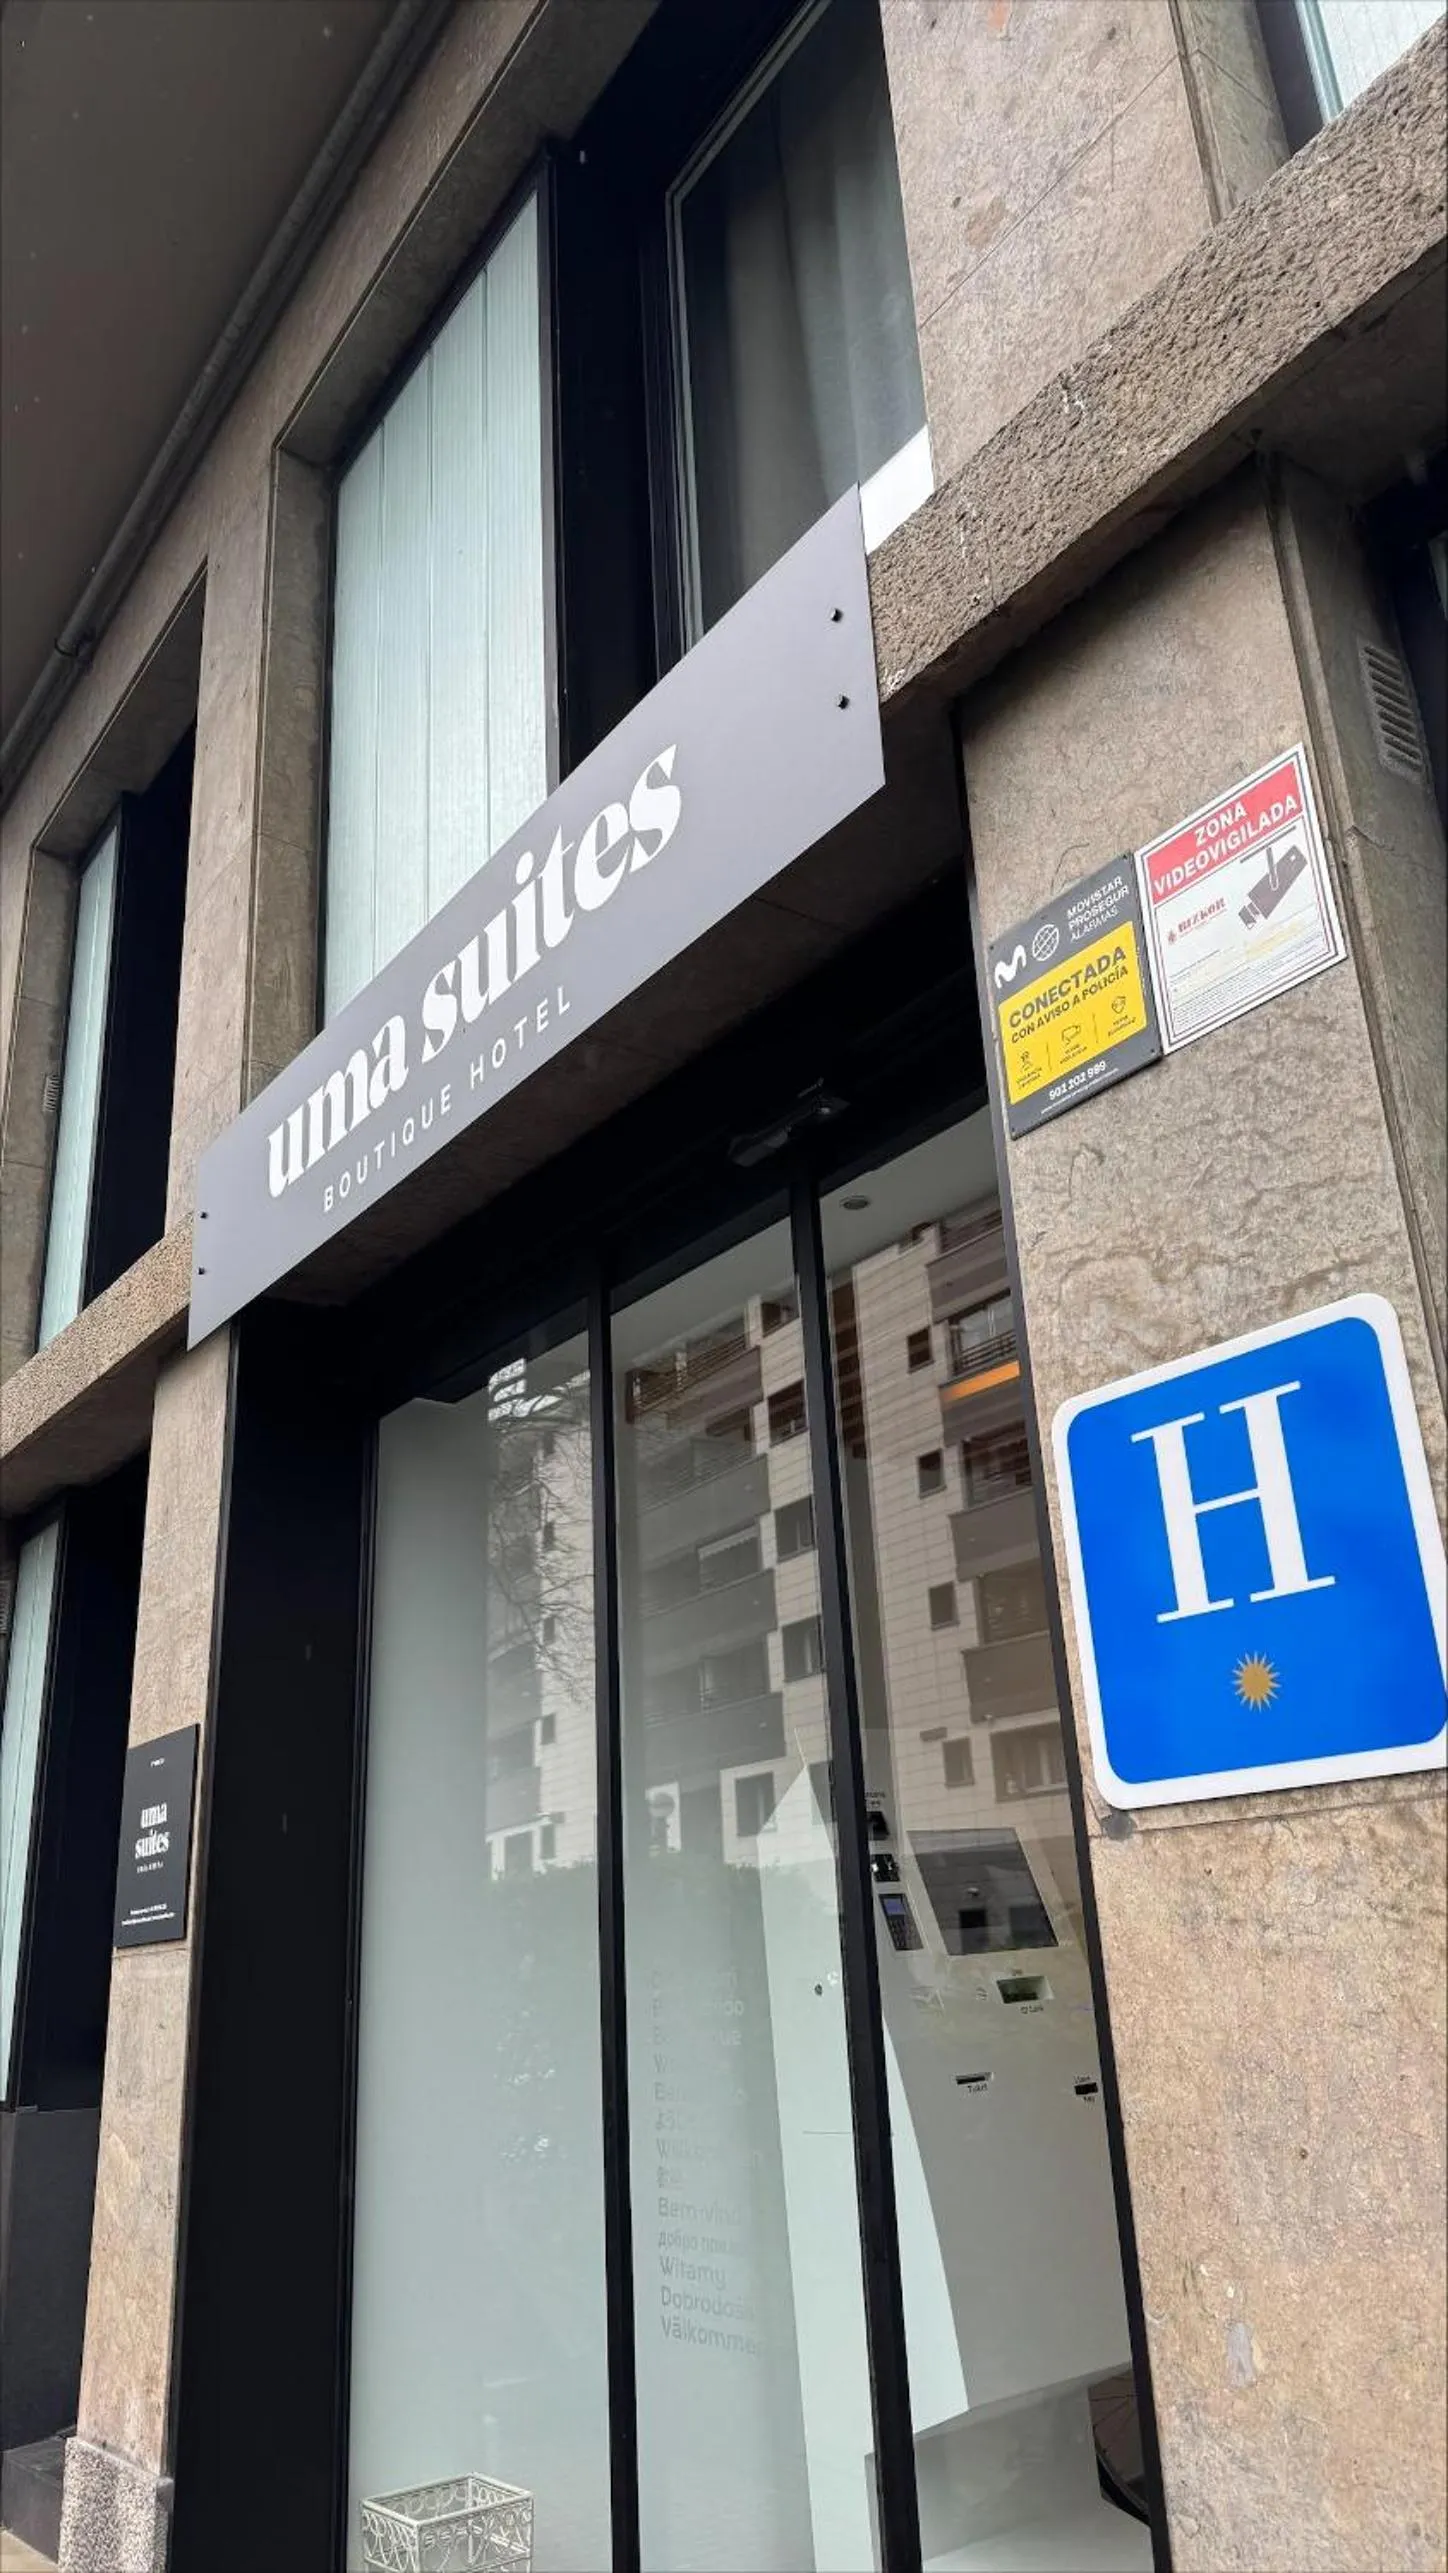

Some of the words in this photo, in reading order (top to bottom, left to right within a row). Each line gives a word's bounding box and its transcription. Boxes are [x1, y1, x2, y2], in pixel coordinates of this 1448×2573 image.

[1153, 795, 1298, 896] VIDEOVIGILADA
[1194, 801, 1247, 847] ZONA
[1066, 875, 1123, 919] MOVISTAR
[1068, 885, 1130, 931] PROSEGUR
[1070, 907, 1120, 942] ALARMAS
[267, 1015, 410, 1199] uma
[420, 744, 682, 1065] suites
[1008, 947, 1127, 1029] CONECTADA
[1011, 1021, 1035, 1044] CON
[1037, 1001, 1070, 1027] AVISO
[1072, 994, 1081, 1006] A
[1082, 965, 1129, 1001] POLICÍA
[322, 1083, 453, 1212] BOUTIQUE
[468, 985, 572, 1090] HOTEL
[1131, 1380, 1336, 1623] H
[140, 1803, 168, 1829] uma
[135, 1829, 171, 1859] suites
[659, 2255, 727, 2291] Witamy
